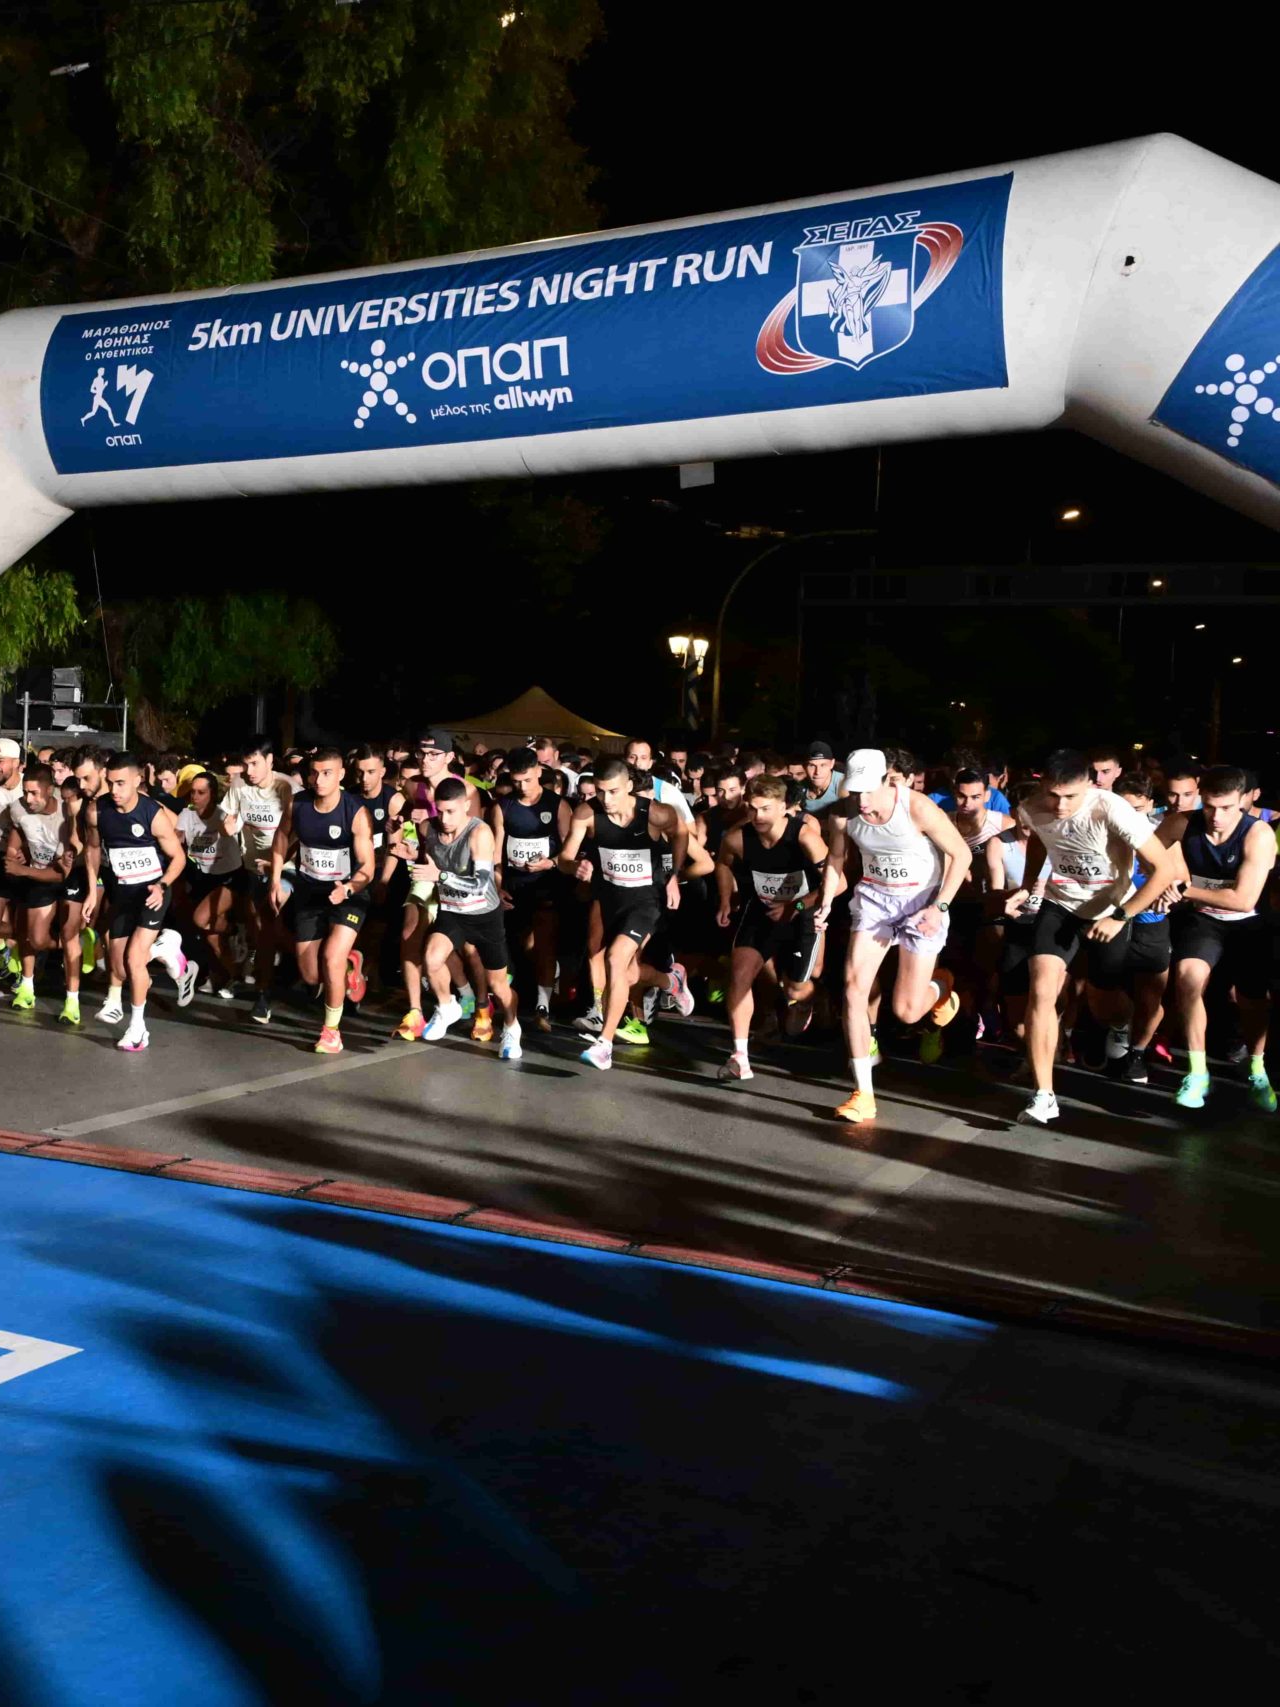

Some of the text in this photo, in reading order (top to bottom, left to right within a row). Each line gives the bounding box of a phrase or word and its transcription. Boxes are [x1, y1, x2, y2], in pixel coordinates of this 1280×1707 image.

[800, 210, 921, 247] ΣΕΓΑΣ
[188, 241, 773, 351] 5km UNIVERSITIES NIGHT RUN
[81, 319, 172, 339] ΜΑΡΑΘΩΝΙΟΣ
[94, 333, 151, 350] ΑΘΗΝΑΣ
[94, 345, 154, 360] ΑΥΘΕΝΤΙΚΟΣ
[430, 385, 573, 420] μέλος της allwyn
[246, 813, 274, 823] 95940
[119, 857, 152, 871] 95199
[607, 861, 644, 873] 96008
[1059, 864, 1101, 877] 96212
